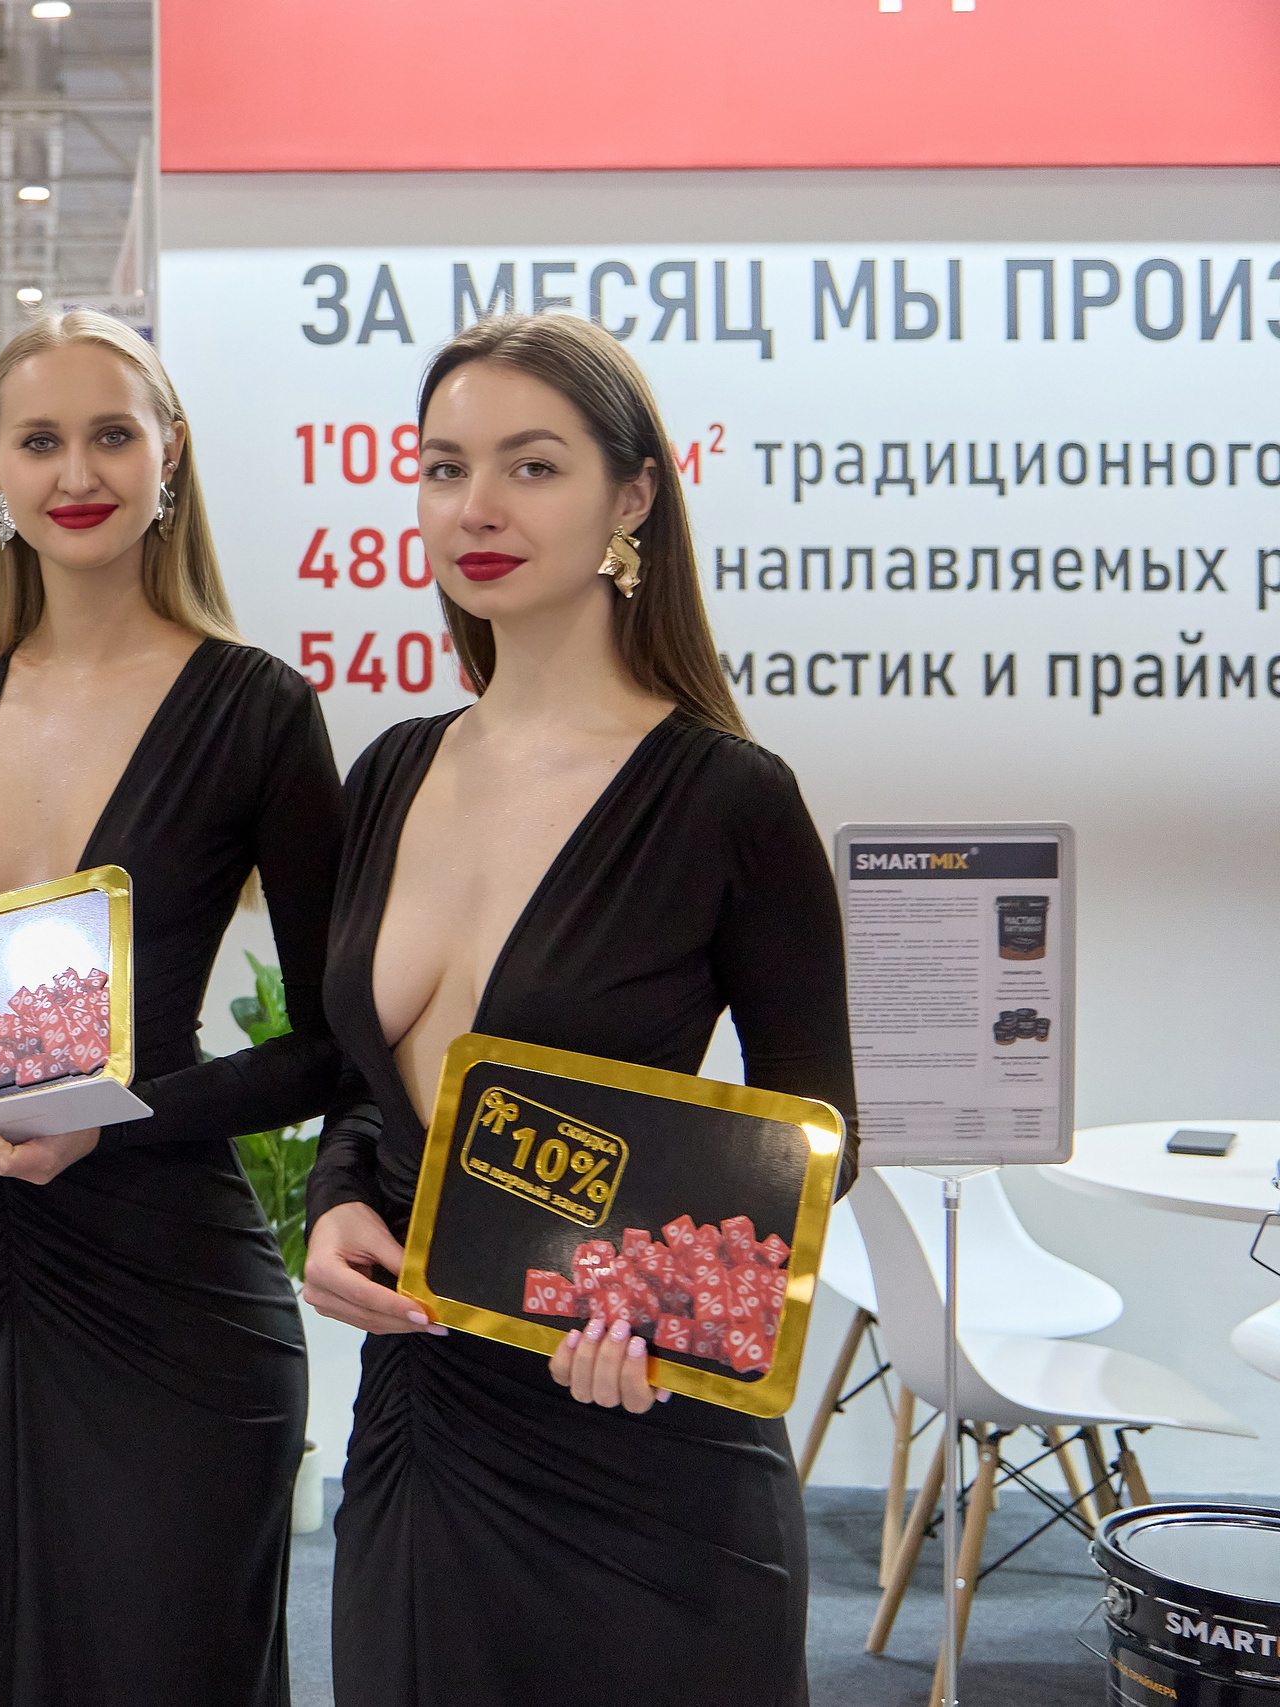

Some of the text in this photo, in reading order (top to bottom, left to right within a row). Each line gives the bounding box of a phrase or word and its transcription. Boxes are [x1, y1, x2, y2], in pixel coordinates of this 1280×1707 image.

[302, 259, 1280, 360] ЗА МЕСЯЦ МЫ ПРОИ
[754, 442, 1280, 502] традиционного
[716, 547, 1226, 592] наплавляемых
[719, 652, 957, 697] мастик
[984, 653, 1016, 697] и
[512, 1127, 611, 1203] 10%
[1165, 1612, 1280, 1657] SMART
